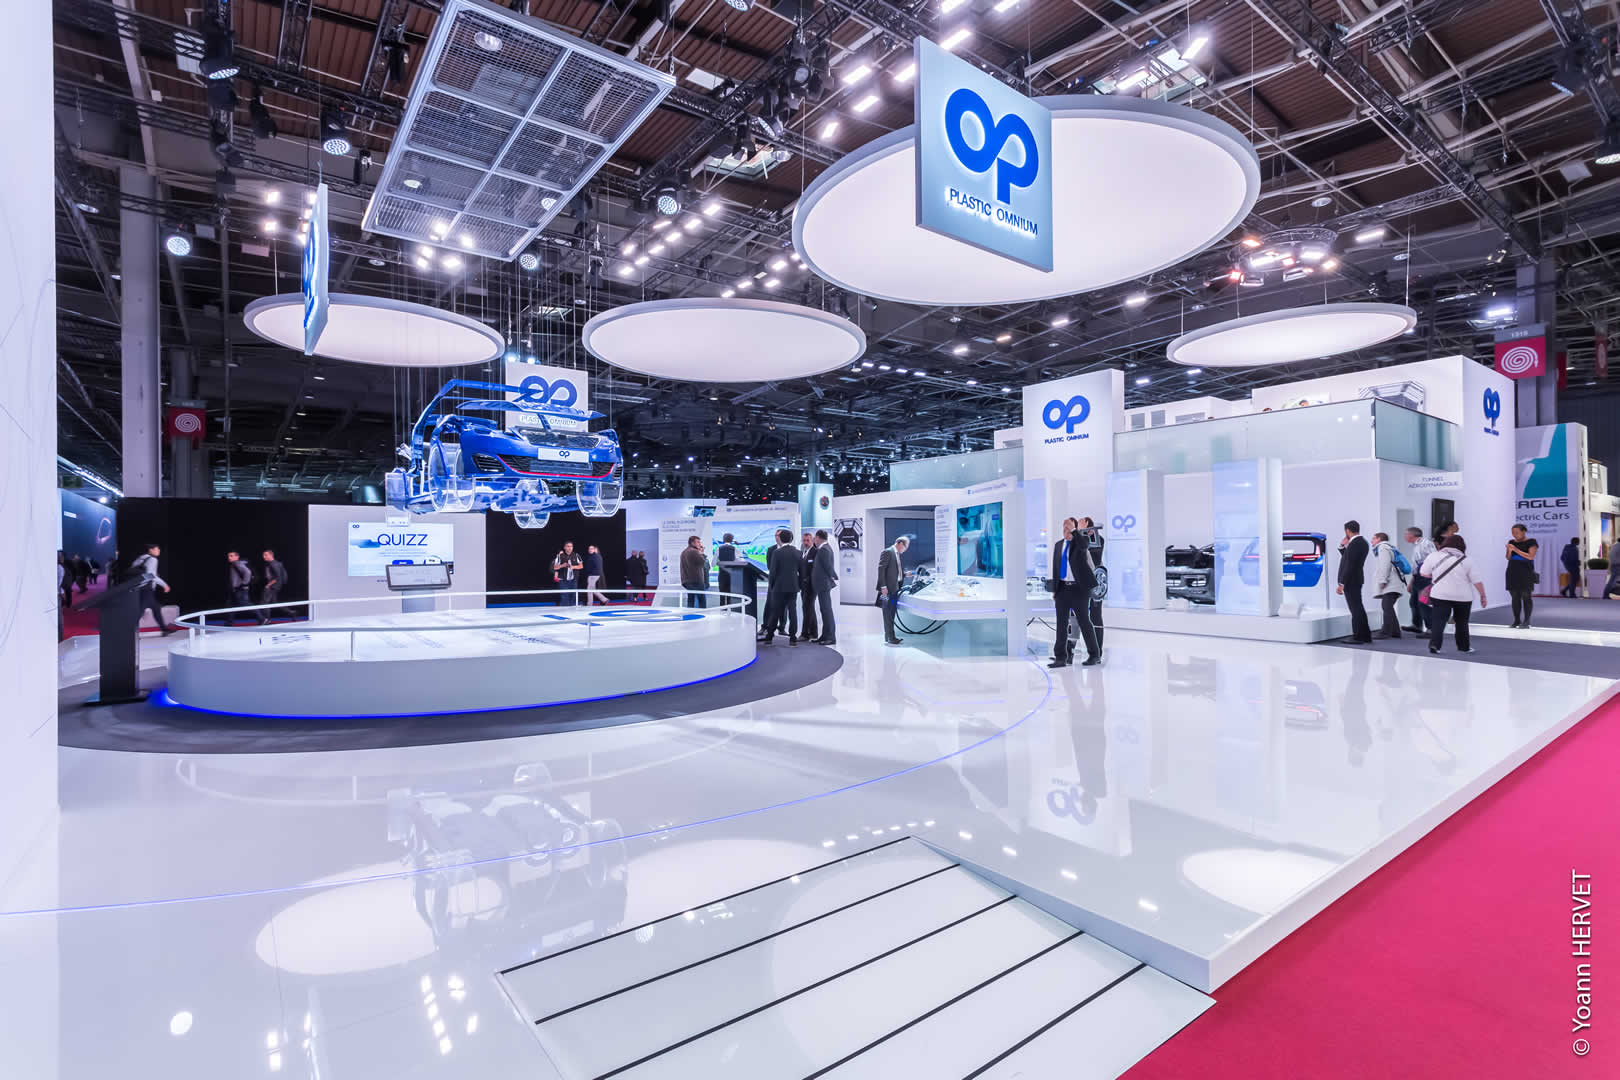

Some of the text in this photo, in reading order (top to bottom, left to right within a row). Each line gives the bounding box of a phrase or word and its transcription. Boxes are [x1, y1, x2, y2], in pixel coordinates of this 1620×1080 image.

[950, 188, 1038, 235] PLASTIC OMNIUM
[1044, 433, 1089, 444] PLASTIC OMNIUM
[1516, 498, 1568, 509] AGLE
[1543, 511, 1570, 520] Cars
[377, 533, 428, 546] QUIZZ
